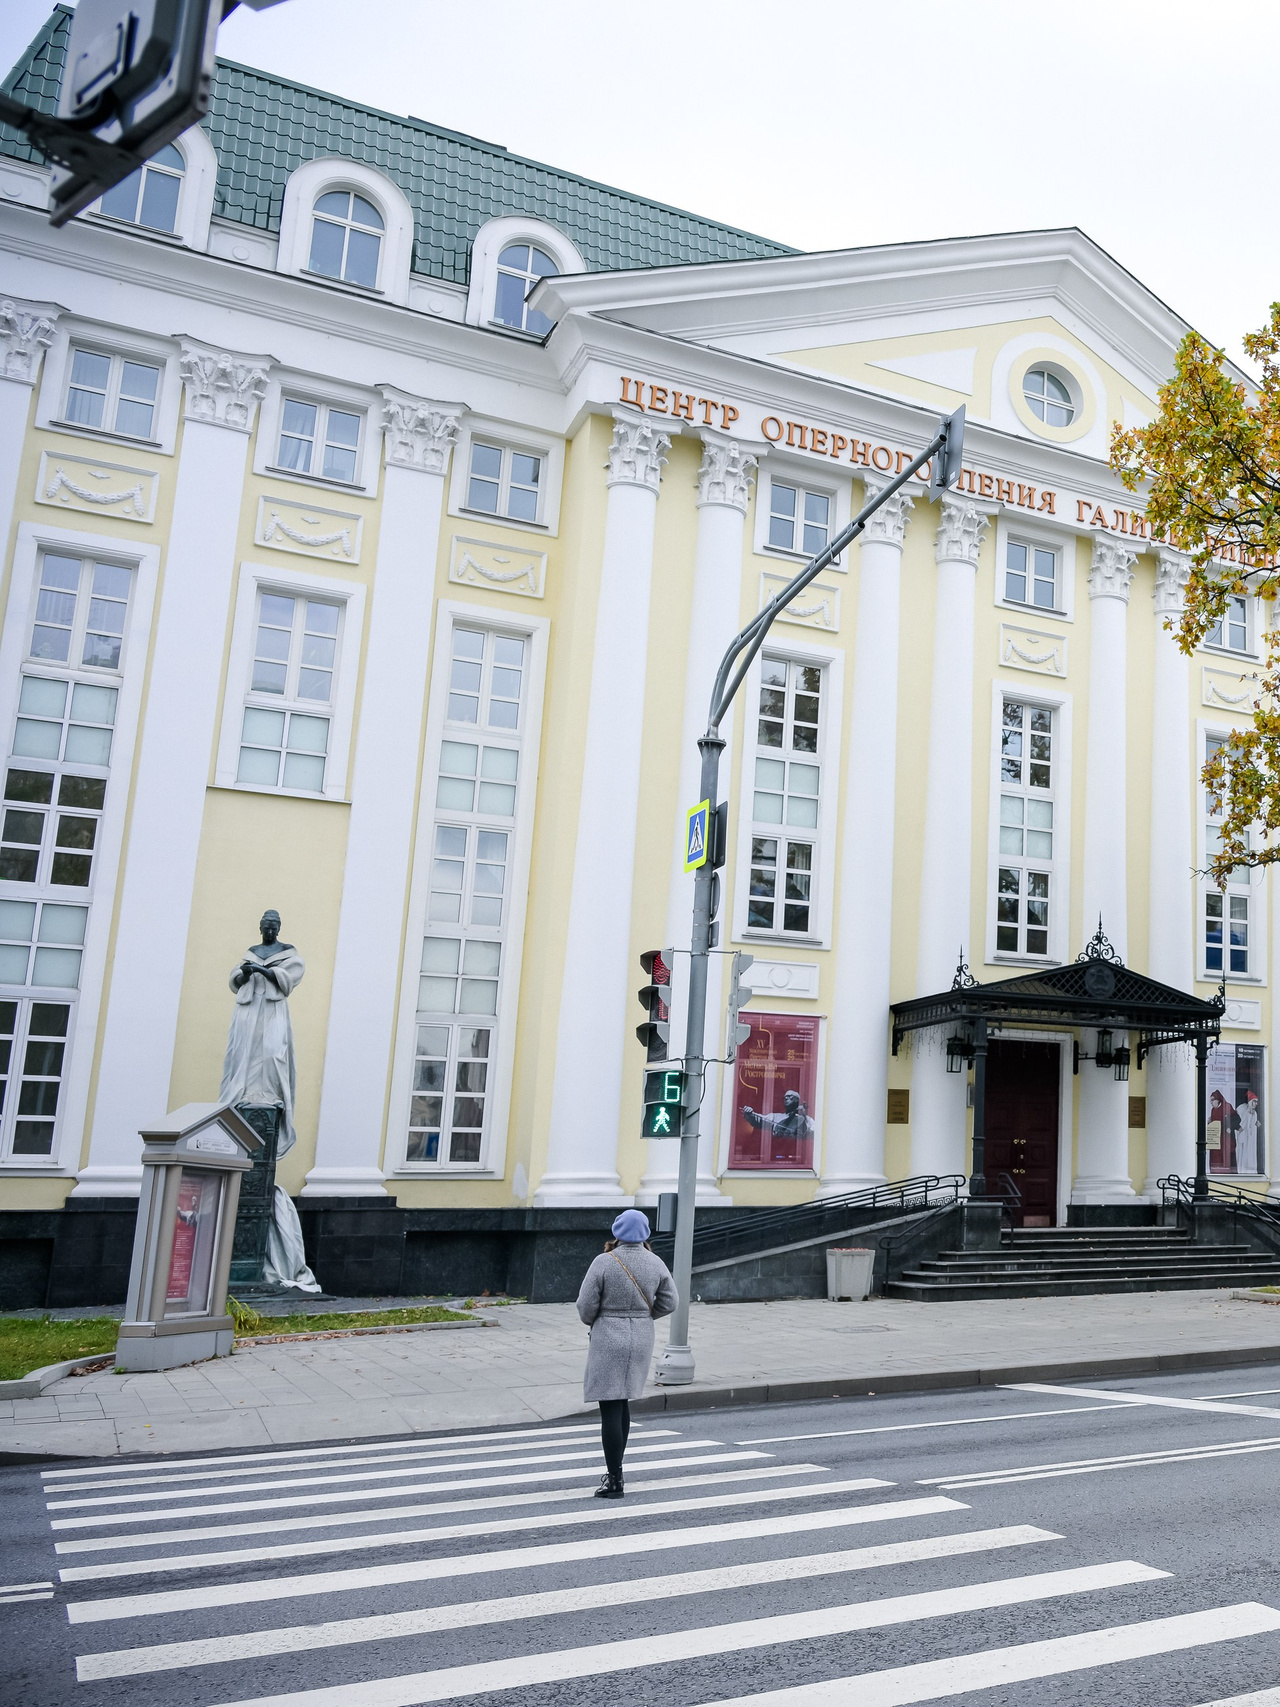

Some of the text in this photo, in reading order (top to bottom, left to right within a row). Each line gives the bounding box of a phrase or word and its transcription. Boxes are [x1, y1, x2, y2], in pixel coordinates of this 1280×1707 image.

[619, 376, 740, 430] ЦЕНТР
[761, 415, 932, 481] ОПЕРНОГО
[956, 468, 1056, 514] ПЕНИЯ
[1076, 499, 1182, 547] ГАЛИН
[665, 1071, 680, 1102] 6
